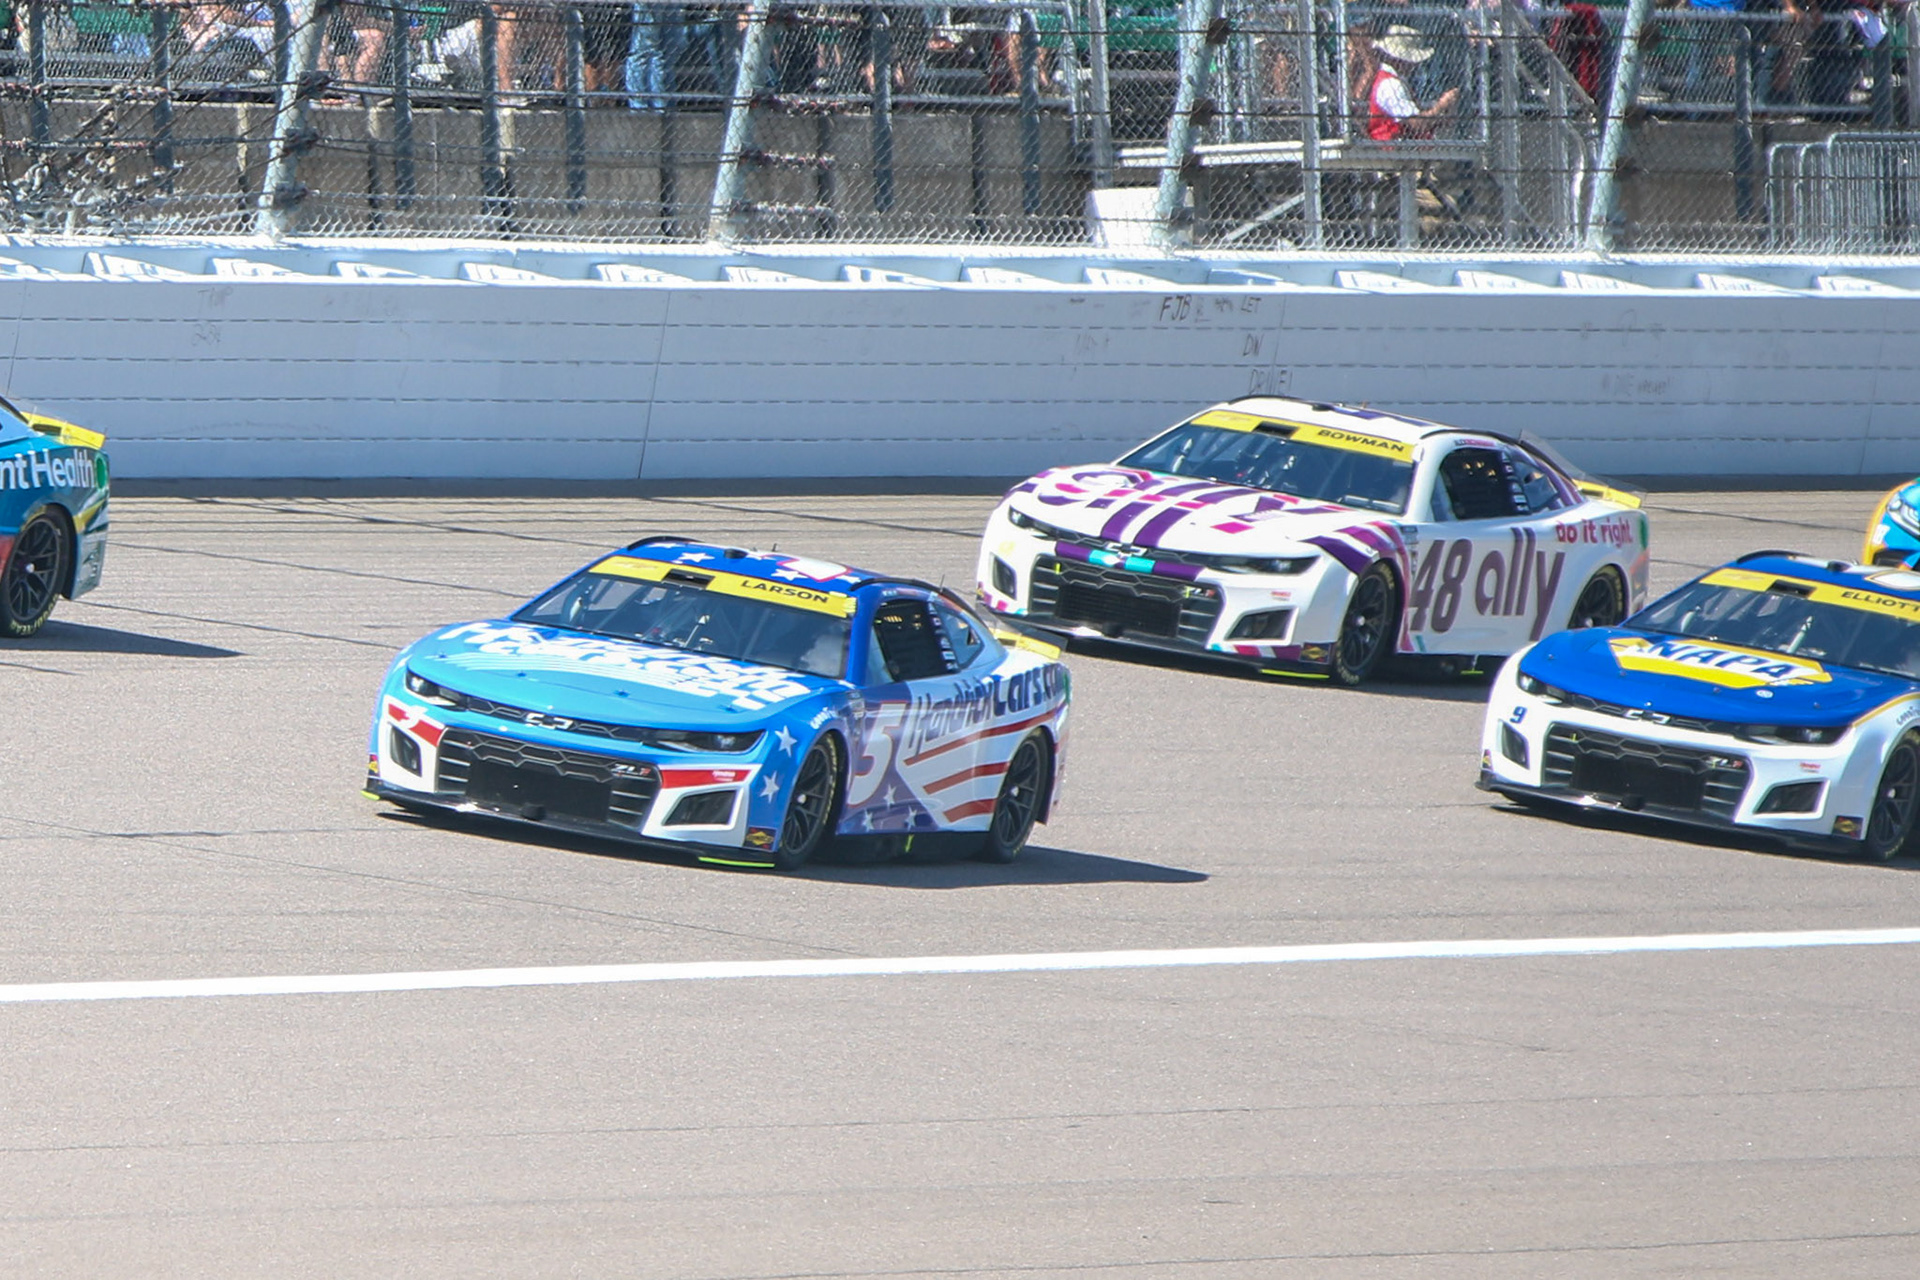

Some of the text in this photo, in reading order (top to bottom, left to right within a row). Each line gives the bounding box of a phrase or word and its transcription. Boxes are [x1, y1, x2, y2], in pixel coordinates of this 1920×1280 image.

[1159, 293, 1192, 321] FJB
[1317, 429, 1405, 452] BOWMAN
[1555, 520, 1577, 543] do
[1582, 518, 1598, 543] it
[740, 580, 830, 604] LARSON
[1408, 538, 1473, 633] 48
[1475, 527, 1566, 642] ally
[1842, 591, 1920, 613] ELLIOTT
[1646, 642, 1803, 678] NAPA
[1509, 705, 1528, 724] 9
[847, 700, 909, 809] 5
[610, 763, 652, 776] ZL1
